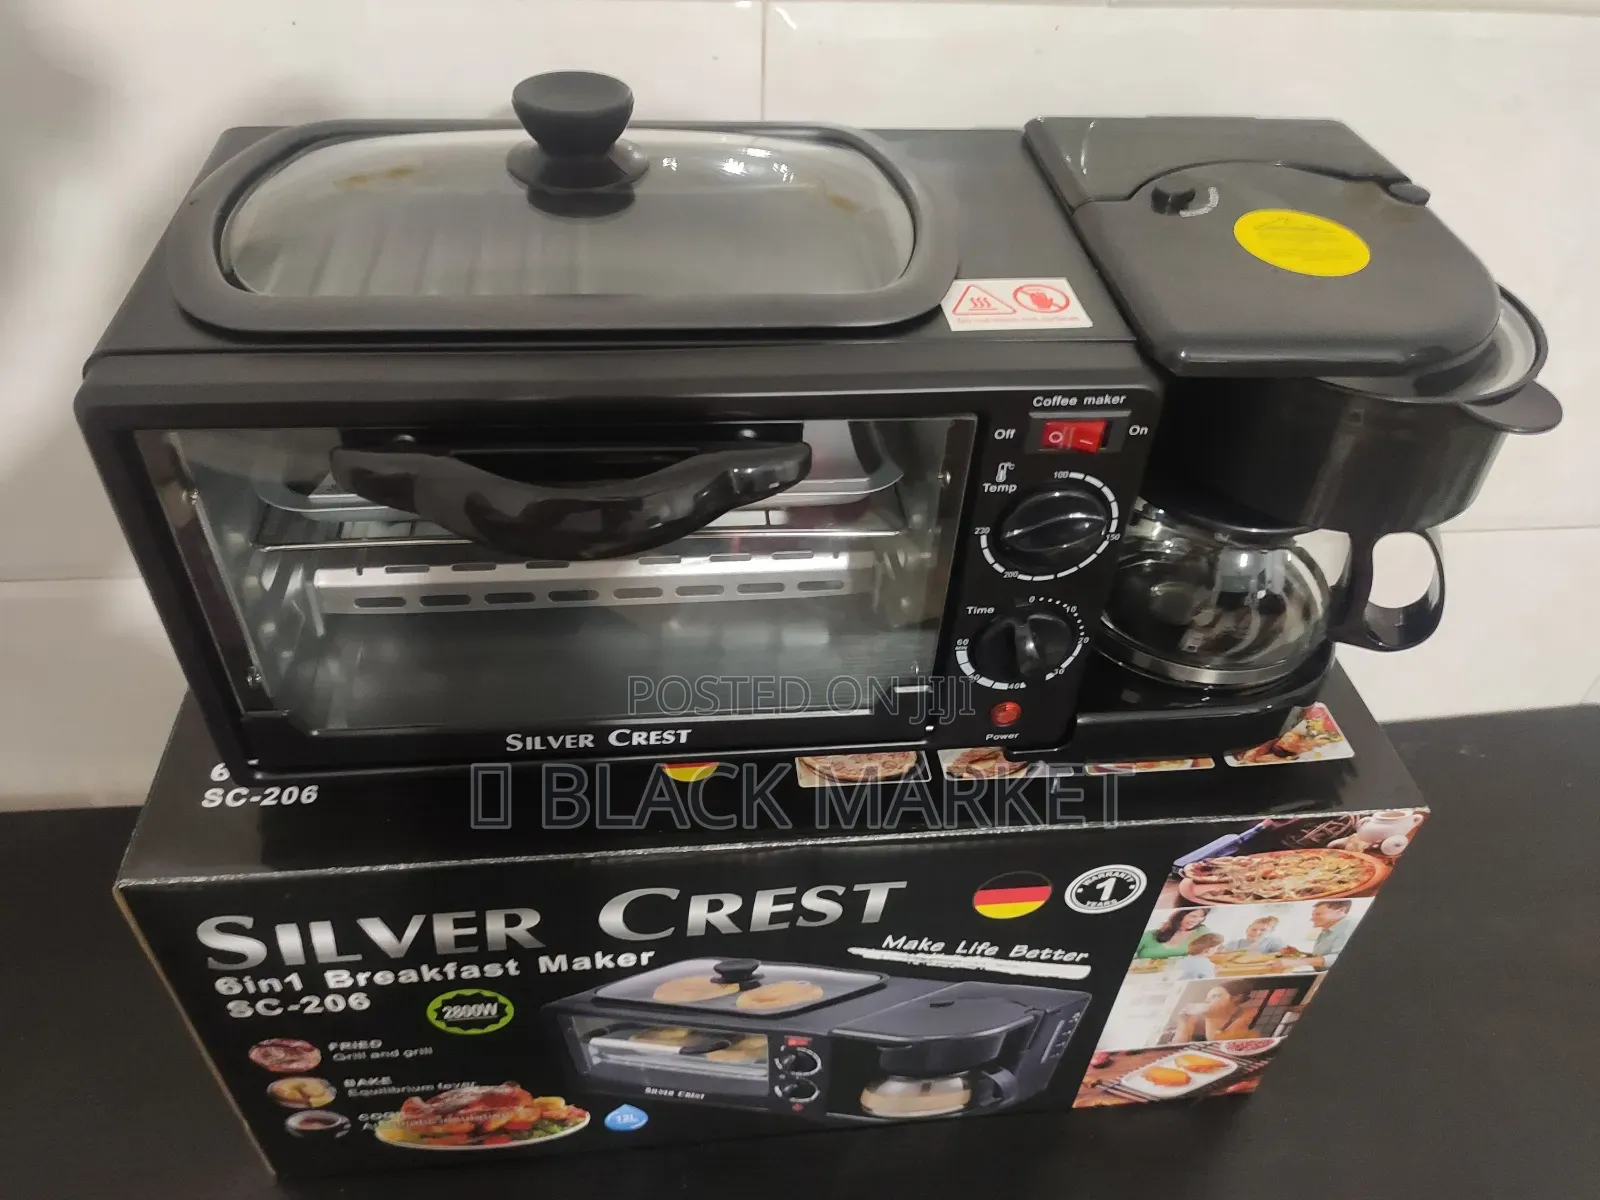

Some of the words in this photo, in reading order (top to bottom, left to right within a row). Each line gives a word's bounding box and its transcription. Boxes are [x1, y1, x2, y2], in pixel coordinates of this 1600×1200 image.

[1032, 396, 1077, 407] Coffee
[1083, 394, 1126, 406] maker
[994, 428, 1016, 440] Off
[1128, 424, 1148, 436] On
[1053, 470, 1069, 479] 100
[983, 483, 1017, 494] Temp
[974, 526, 990, 535] 230
[1105, 532, 1120, 541] 150
[1003, 570, 1019, 579] 200
[1028, 595, 1036, 603] 0
[966, 606, 995, 615] Time
[1065, 604, 1077, 614] 10
[956, 638, 970, 646] 60
[1078, 635, 1090, 644] 20
[1053, 667, 1065, 675] 30
[1008, 682, 1020, 690] 40
[985, 733, 1020, 741] Power
[201, 784, 319, 808] SC-206
[1096, 877, 1117, 902] 1
[1085, 898, 1118, 908] YEARS
[195, 907, 546, 971] SILVER
[598, 880, 908, 941] CREST
[881, 934, 946, 952] Make
[955, 939, 1000, 956] Life
[1008, 944, 1089, 962] Better
[214, 974, 304, 996] 6in1
[324, 957, 521, 991] Breakfast
[538, 948, 656, 976] Maker
[226, 993, 371, 1020] SC-206
[442, 1002, 499, 1020] 2800W
[328, 1039, 383, 1051] FRIED
[332, 1052, 367, 1062] Grill
[370, 1049, 400, 1060] and
[403, 1046, 433, 1059] grill
[343, 1076, 392, 1088] BAKE
[616, 1114, 637, 1123] 12L
